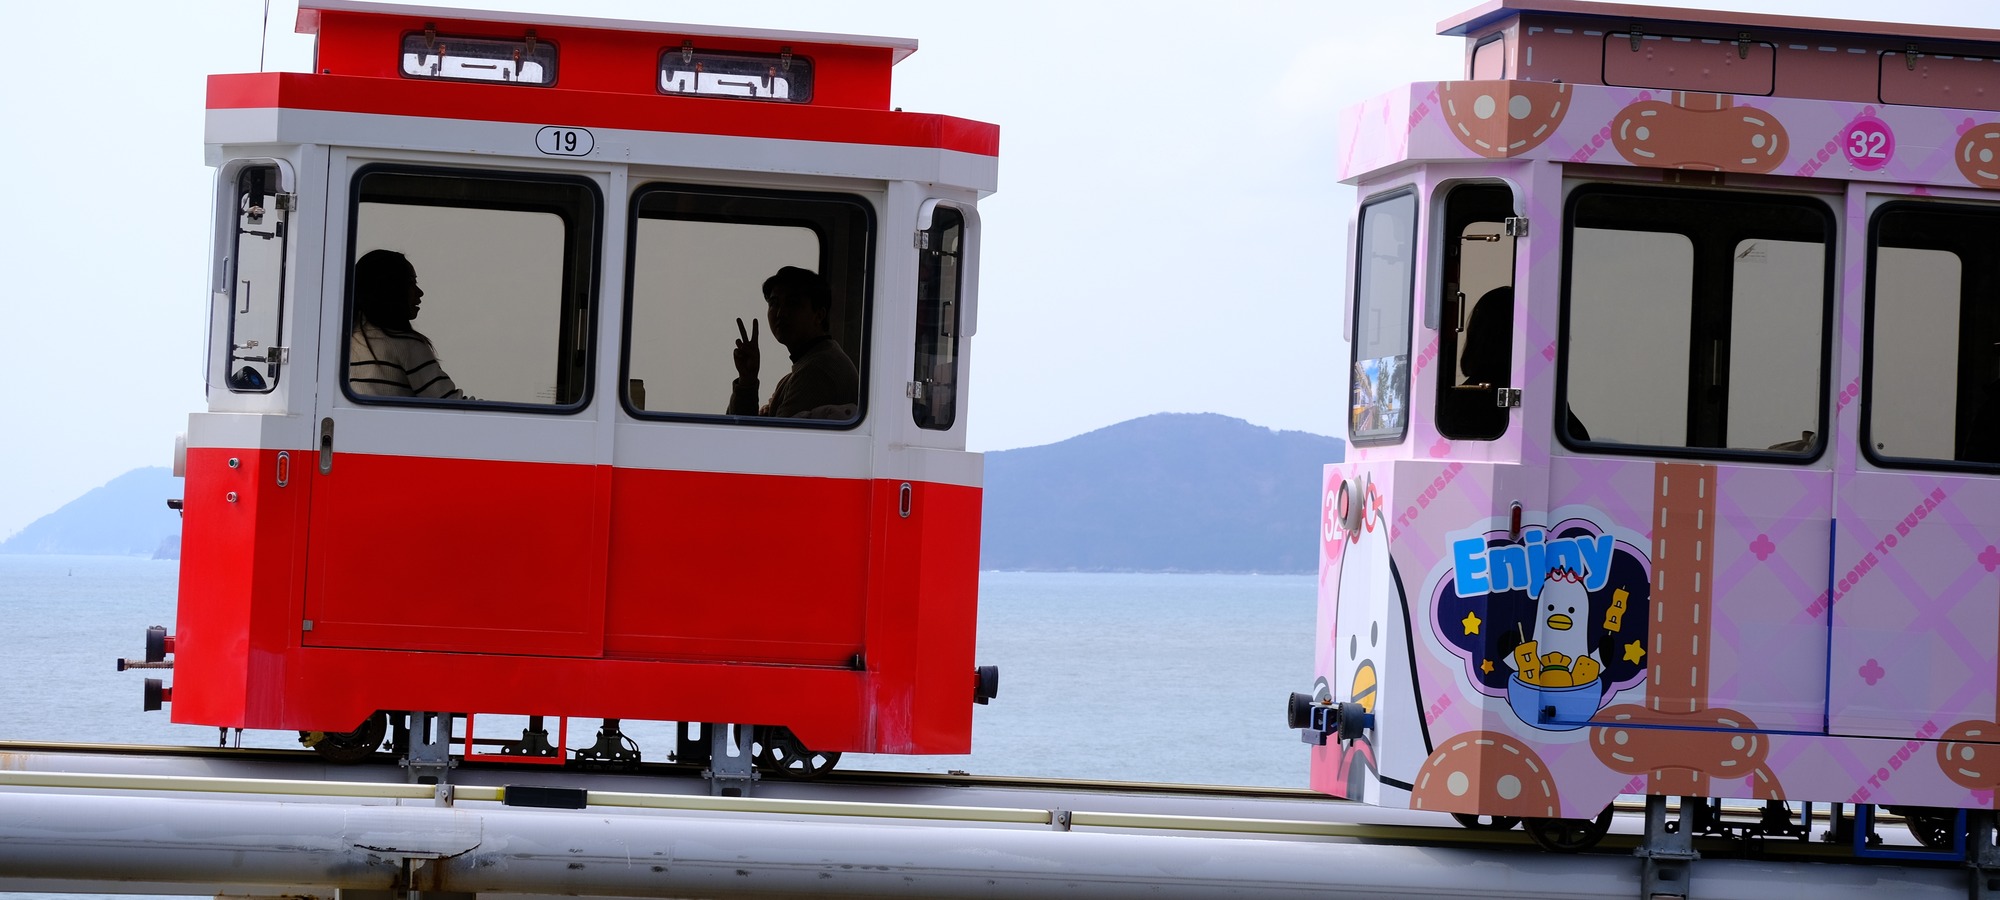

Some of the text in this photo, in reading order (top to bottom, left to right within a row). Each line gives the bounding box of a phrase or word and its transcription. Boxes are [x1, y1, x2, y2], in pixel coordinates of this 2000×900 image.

[553, 131, 577, 152] 19
[1849, 130, 1886, 159] 32
[1398, 462, 1464, 527] TO BUSAN
[1453, 529, 1615, 599] Enjoy
[1806, 487, 1947, 618] WELCOME TO BUSAN
[1867, 720, 1939, 789] TO BUSAN
